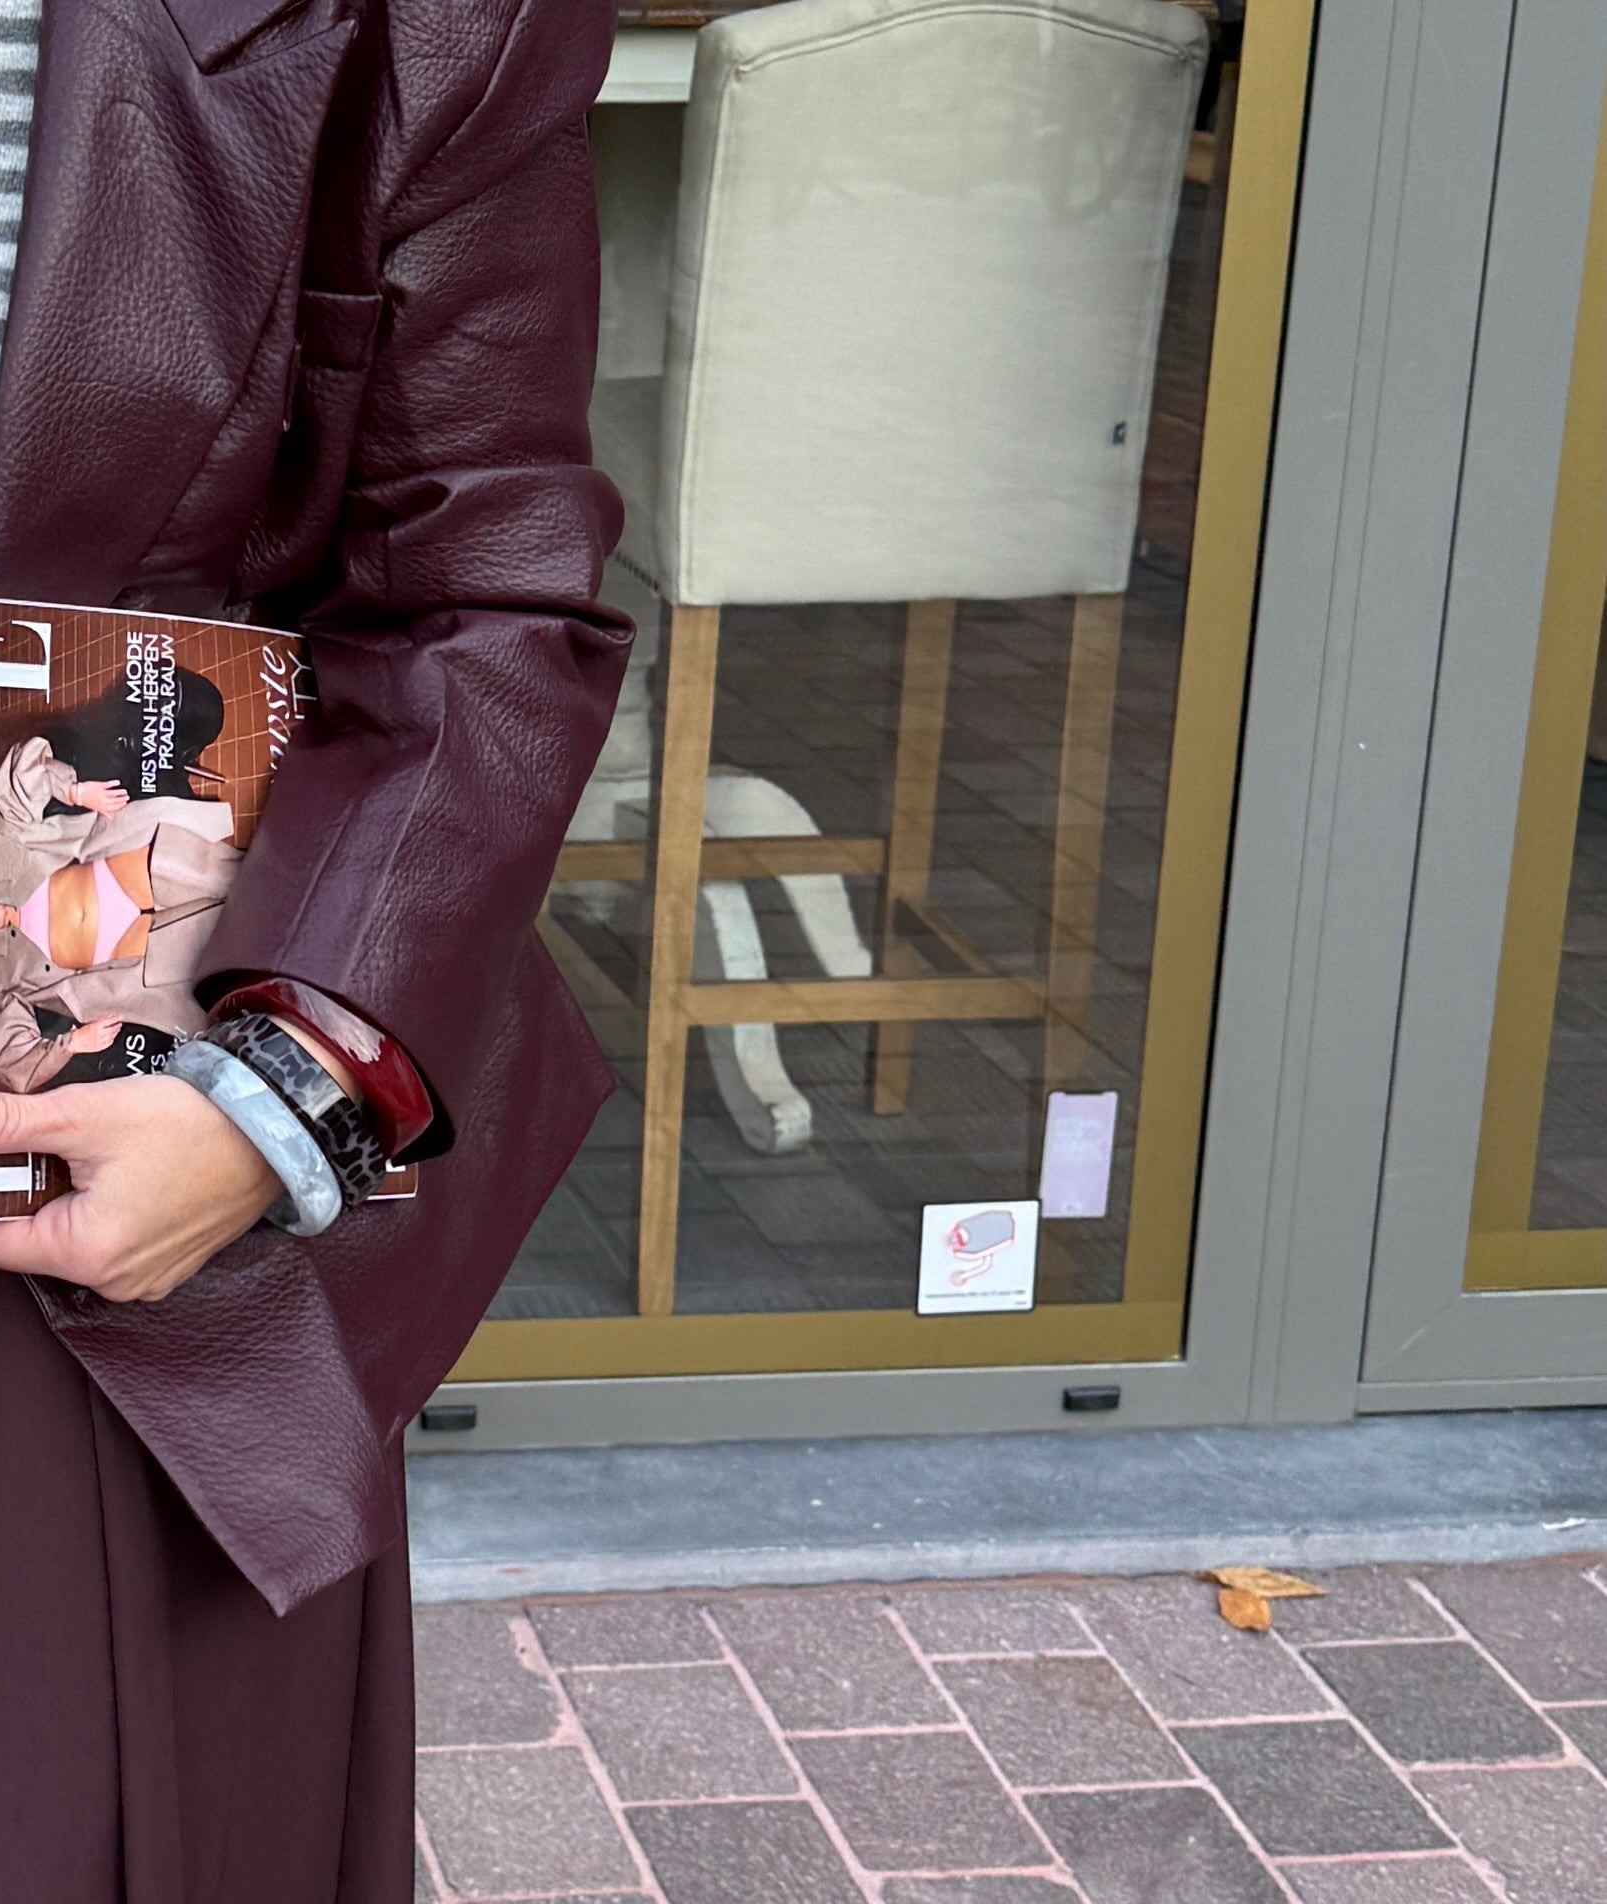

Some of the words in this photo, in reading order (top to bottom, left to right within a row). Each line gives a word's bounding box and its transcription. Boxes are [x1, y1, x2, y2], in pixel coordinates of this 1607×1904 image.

[126, 631, 143, 703] MODE
[143, 633, 160, 713] HERPEN
[160, 633, 176, 697] RAUW
[142, 716, 158, 757] VAN
[141, 760, 157, 793] IRIS
